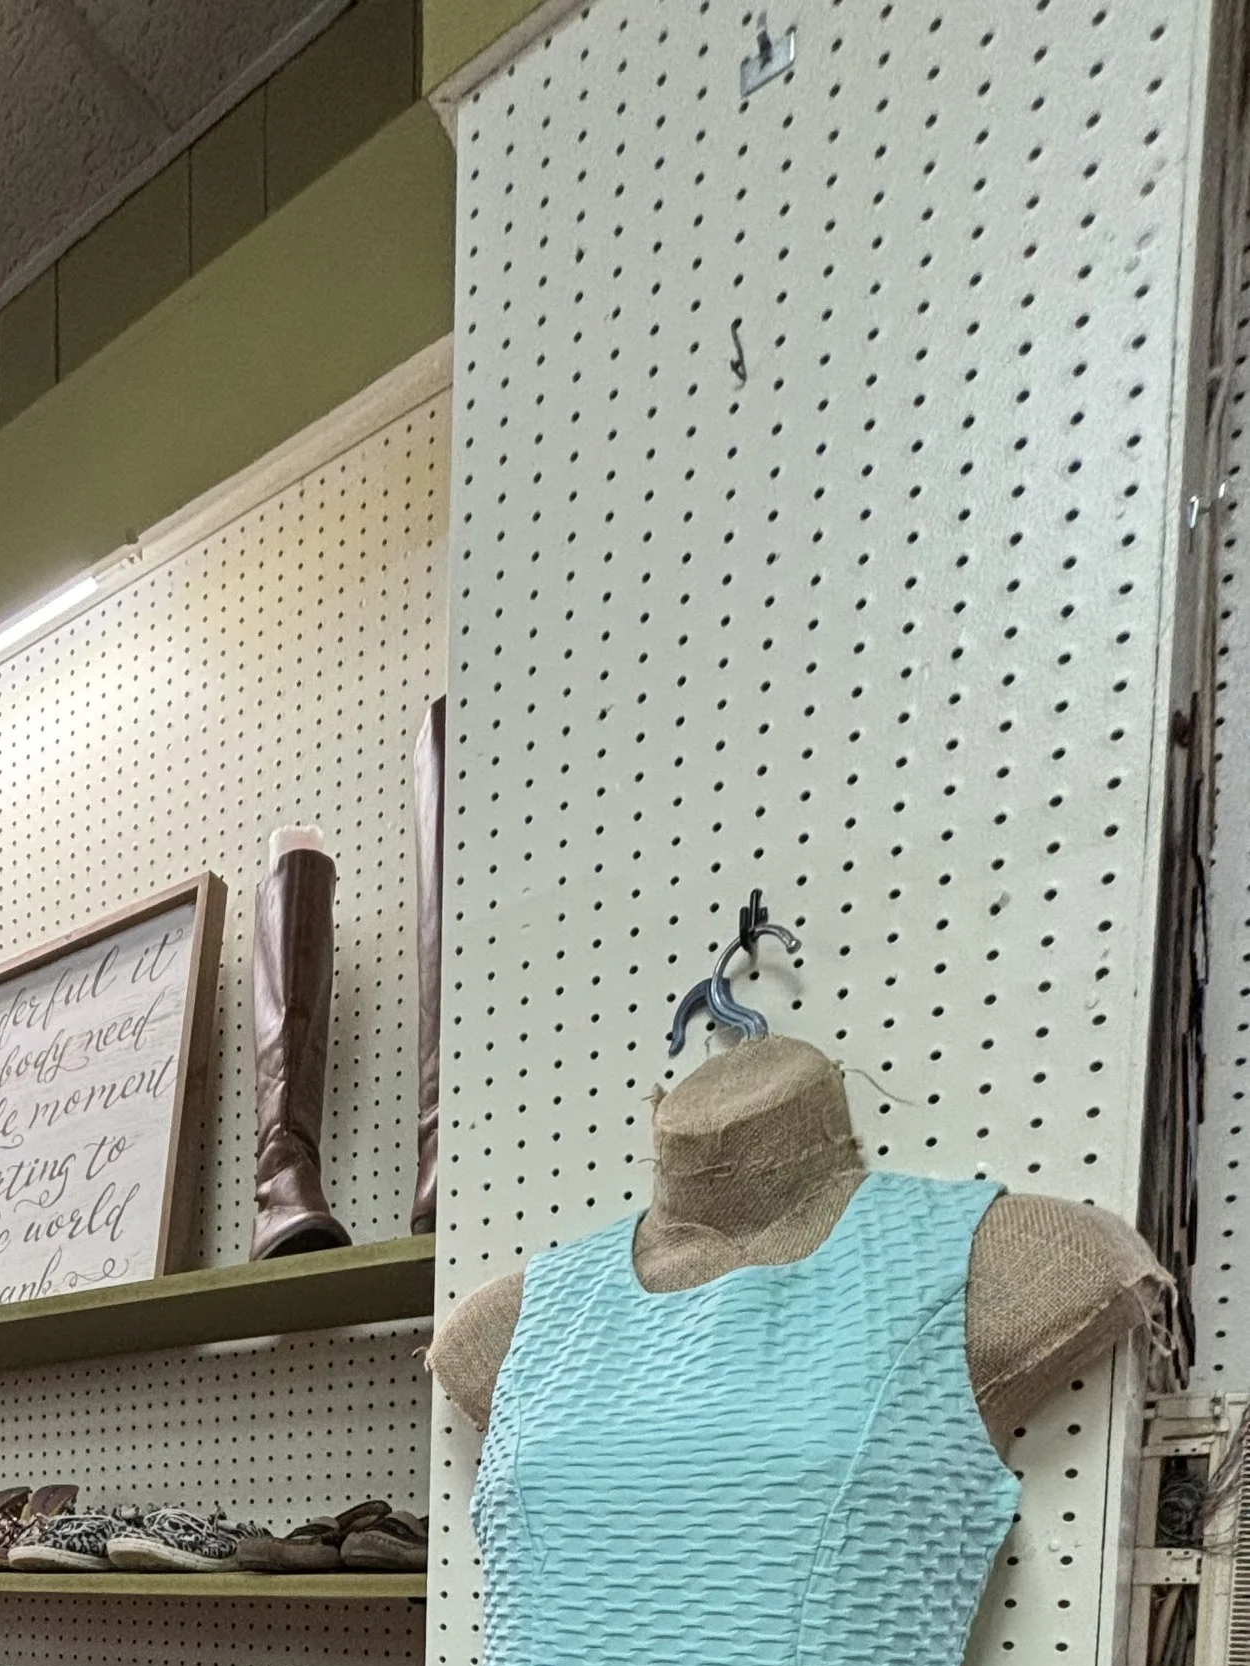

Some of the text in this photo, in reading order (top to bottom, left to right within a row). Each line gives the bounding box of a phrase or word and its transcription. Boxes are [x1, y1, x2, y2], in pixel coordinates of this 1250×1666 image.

[131, 927, 185, 983] it
[84, 991, 167, 1053] need
[28, 1054, 181, 1130] moment
[84, 1134, 136, 1181] to
[23, 1182, 141, 1243] world
